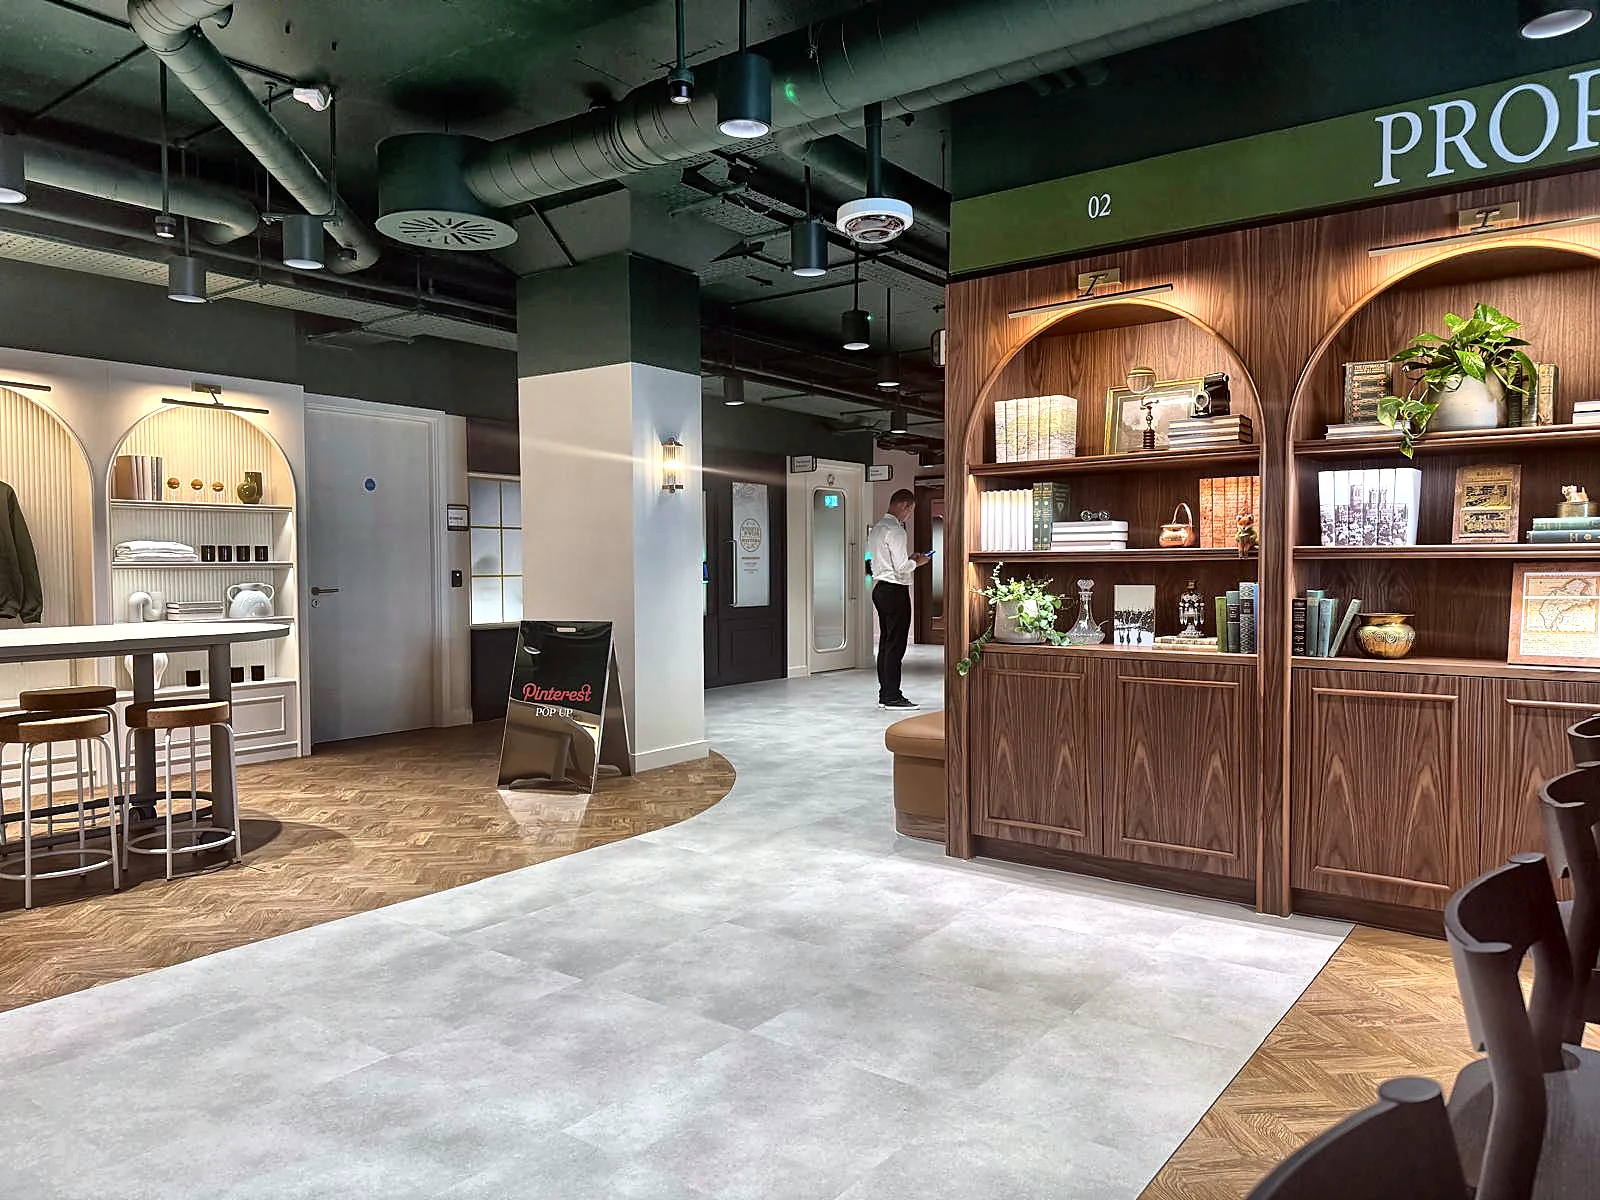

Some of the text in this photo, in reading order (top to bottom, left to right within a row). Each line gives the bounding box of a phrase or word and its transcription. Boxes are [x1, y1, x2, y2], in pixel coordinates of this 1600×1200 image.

[1088, 193, 1111, 219] 02
[522, 682, 592, 703] Pinterest
[535, 707, 573, 717] POP UP
